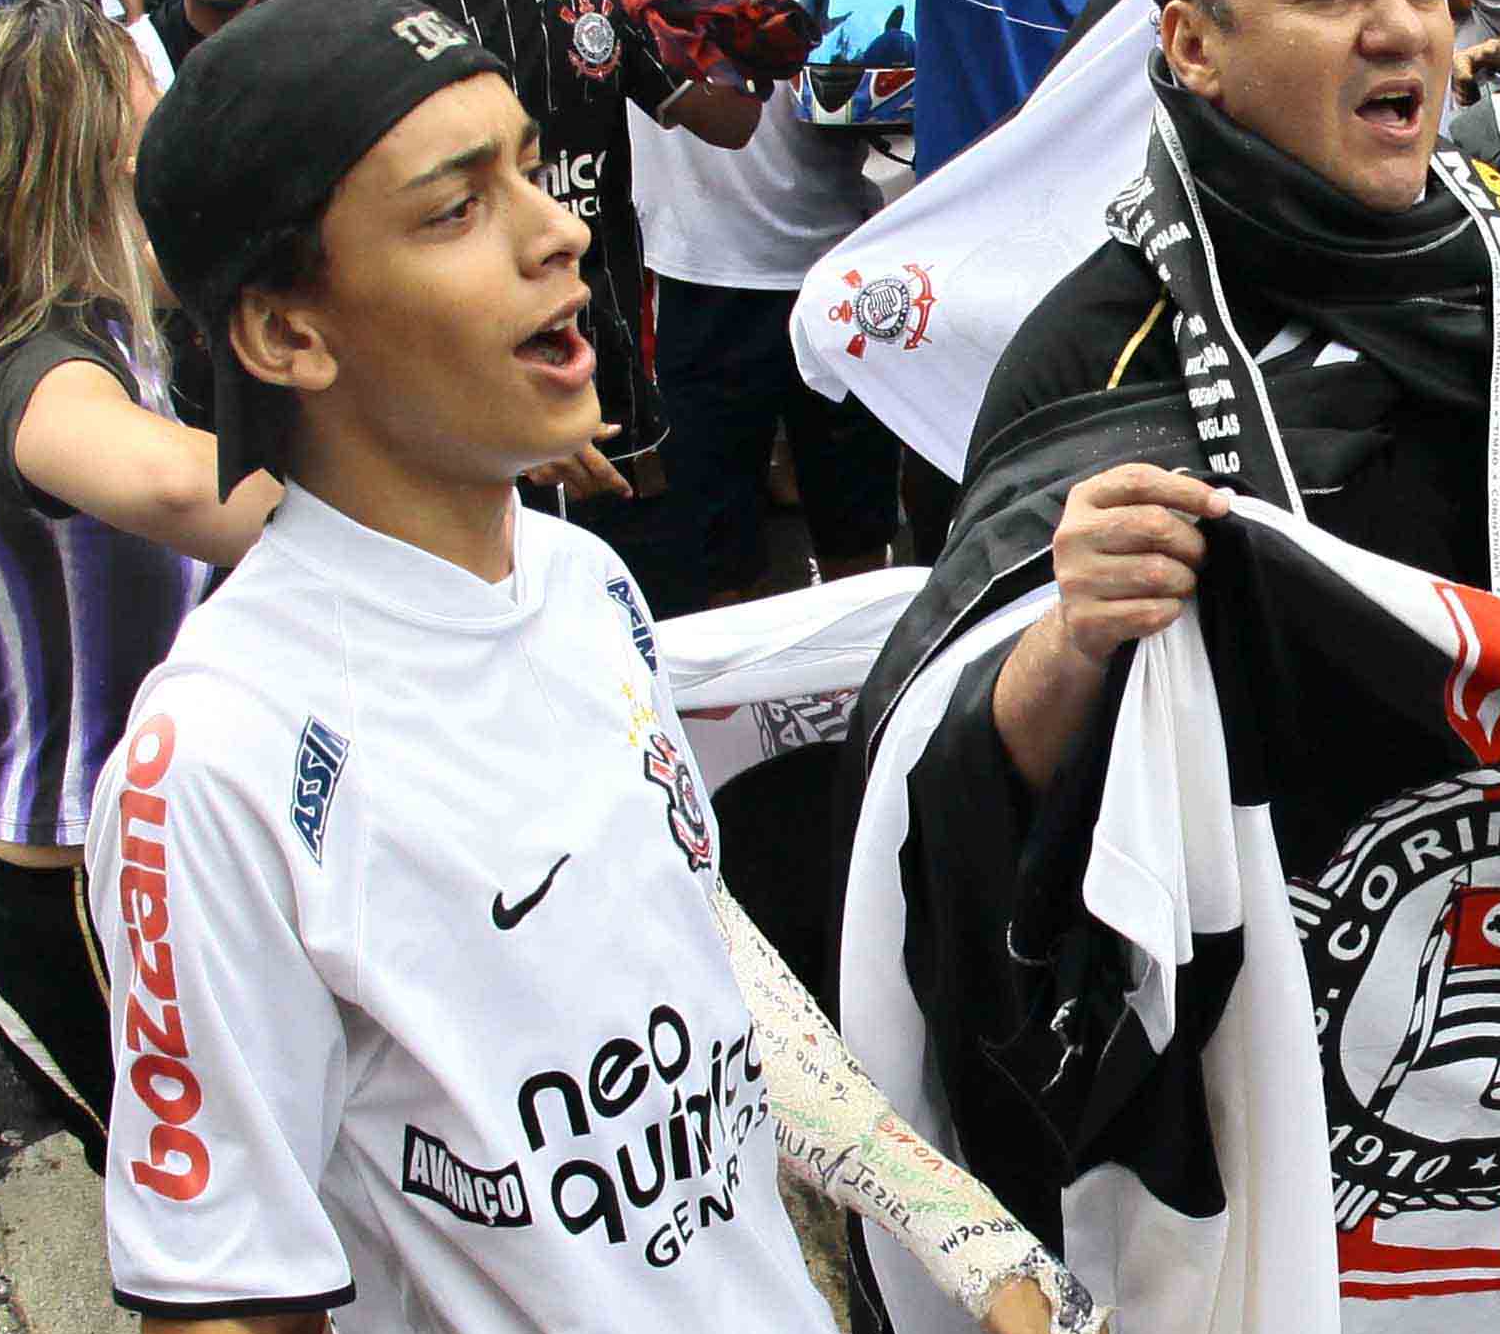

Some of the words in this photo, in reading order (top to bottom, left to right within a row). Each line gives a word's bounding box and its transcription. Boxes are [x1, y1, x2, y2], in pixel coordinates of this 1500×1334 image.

[118, 712, 211, 1204] bozzano
[518, 1003, 693, 1152] neo
[407, 1131, 525, 1226] AVANÇO
